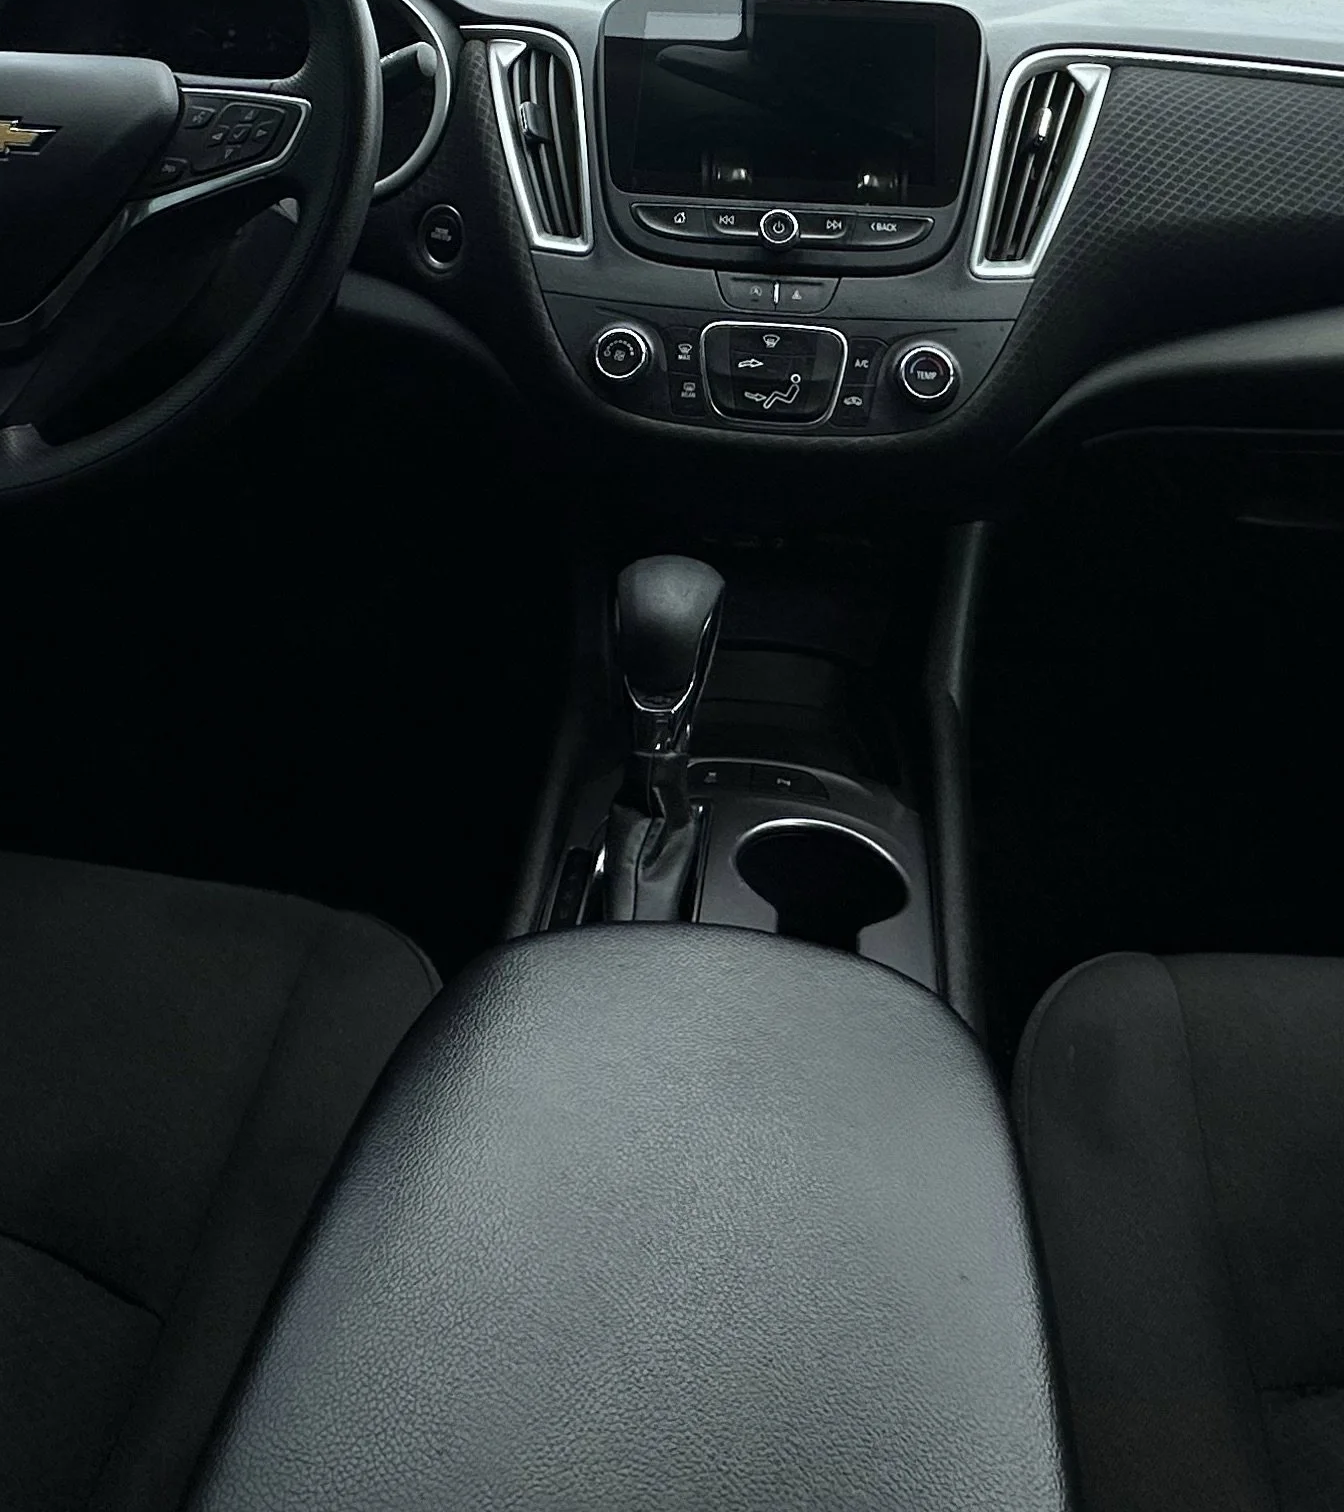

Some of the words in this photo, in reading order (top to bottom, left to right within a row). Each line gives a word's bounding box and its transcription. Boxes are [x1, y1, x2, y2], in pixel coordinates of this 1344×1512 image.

[876, 222, 898, 232] BACK
[854, 358, 869, 368] A/C
[916, 370, 937, 380] TEMP
